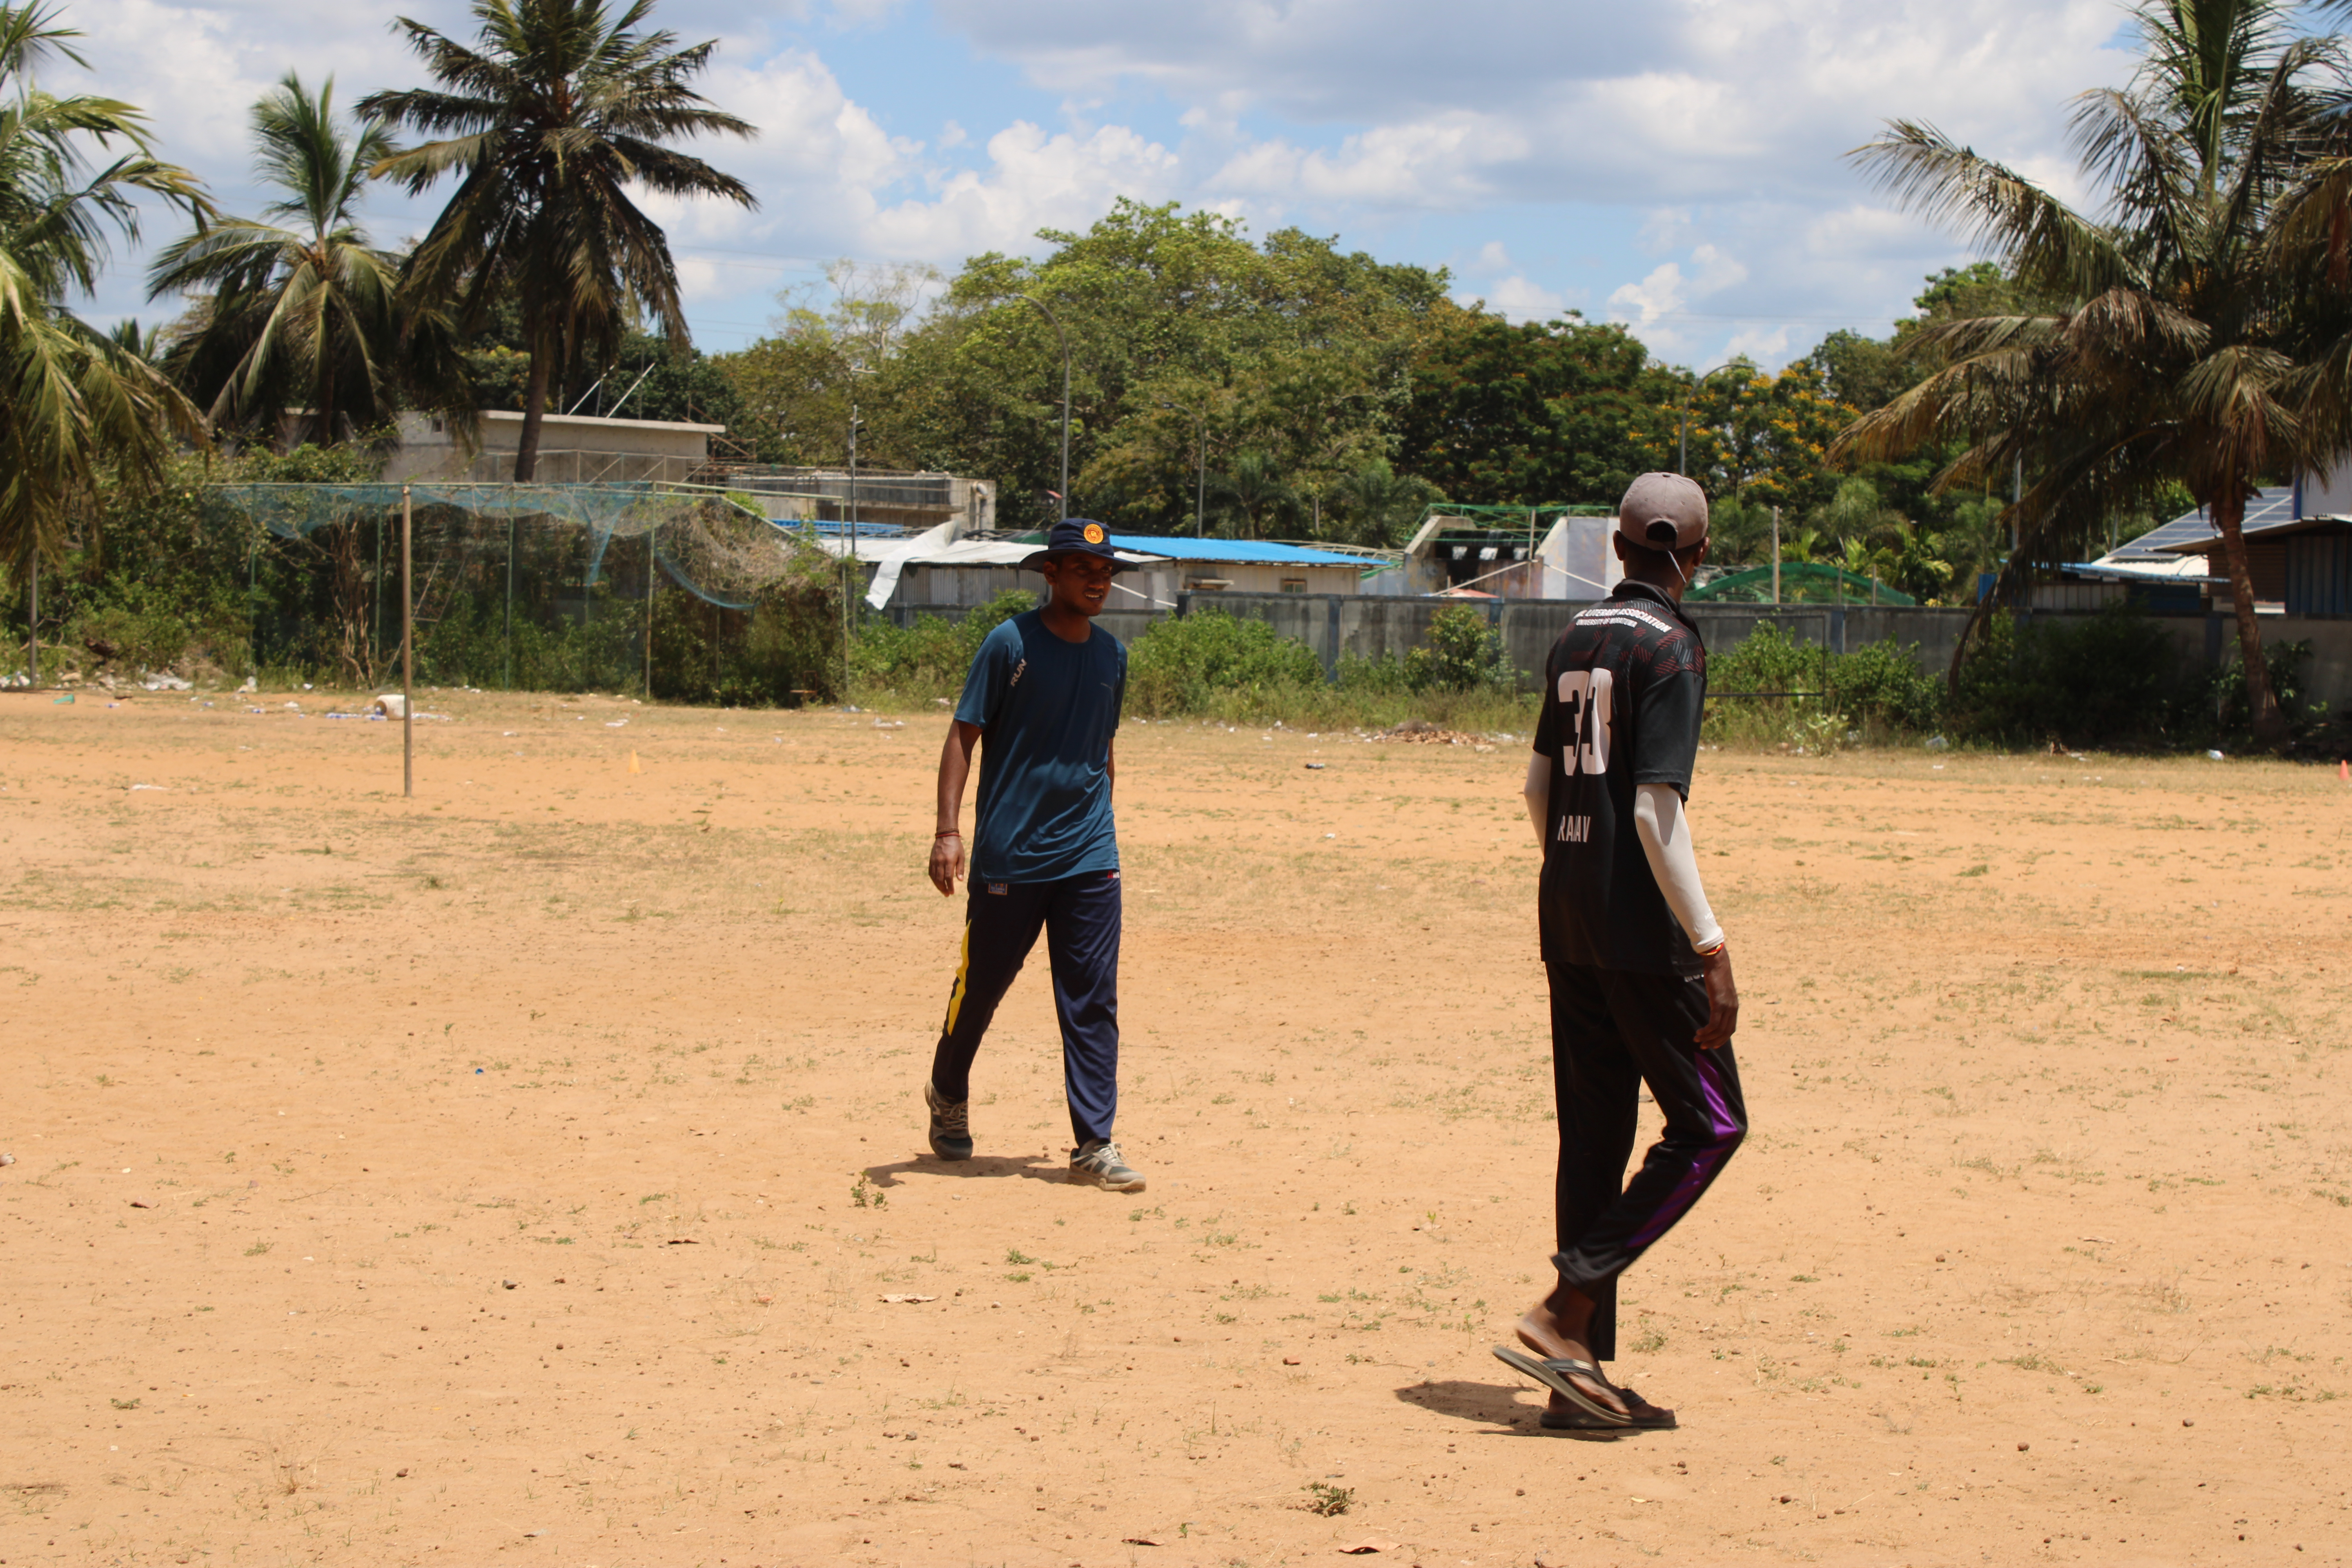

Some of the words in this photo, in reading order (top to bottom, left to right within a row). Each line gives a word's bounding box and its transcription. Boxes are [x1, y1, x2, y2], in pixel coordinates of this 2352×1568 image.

[1585, 608, 1621, 617] LITERARY
[1616, 608, 1673, 633] ASSOCIATION
[1010, 658, 1027, 687] RUN
[1558, 668, 1612, 776] 33
